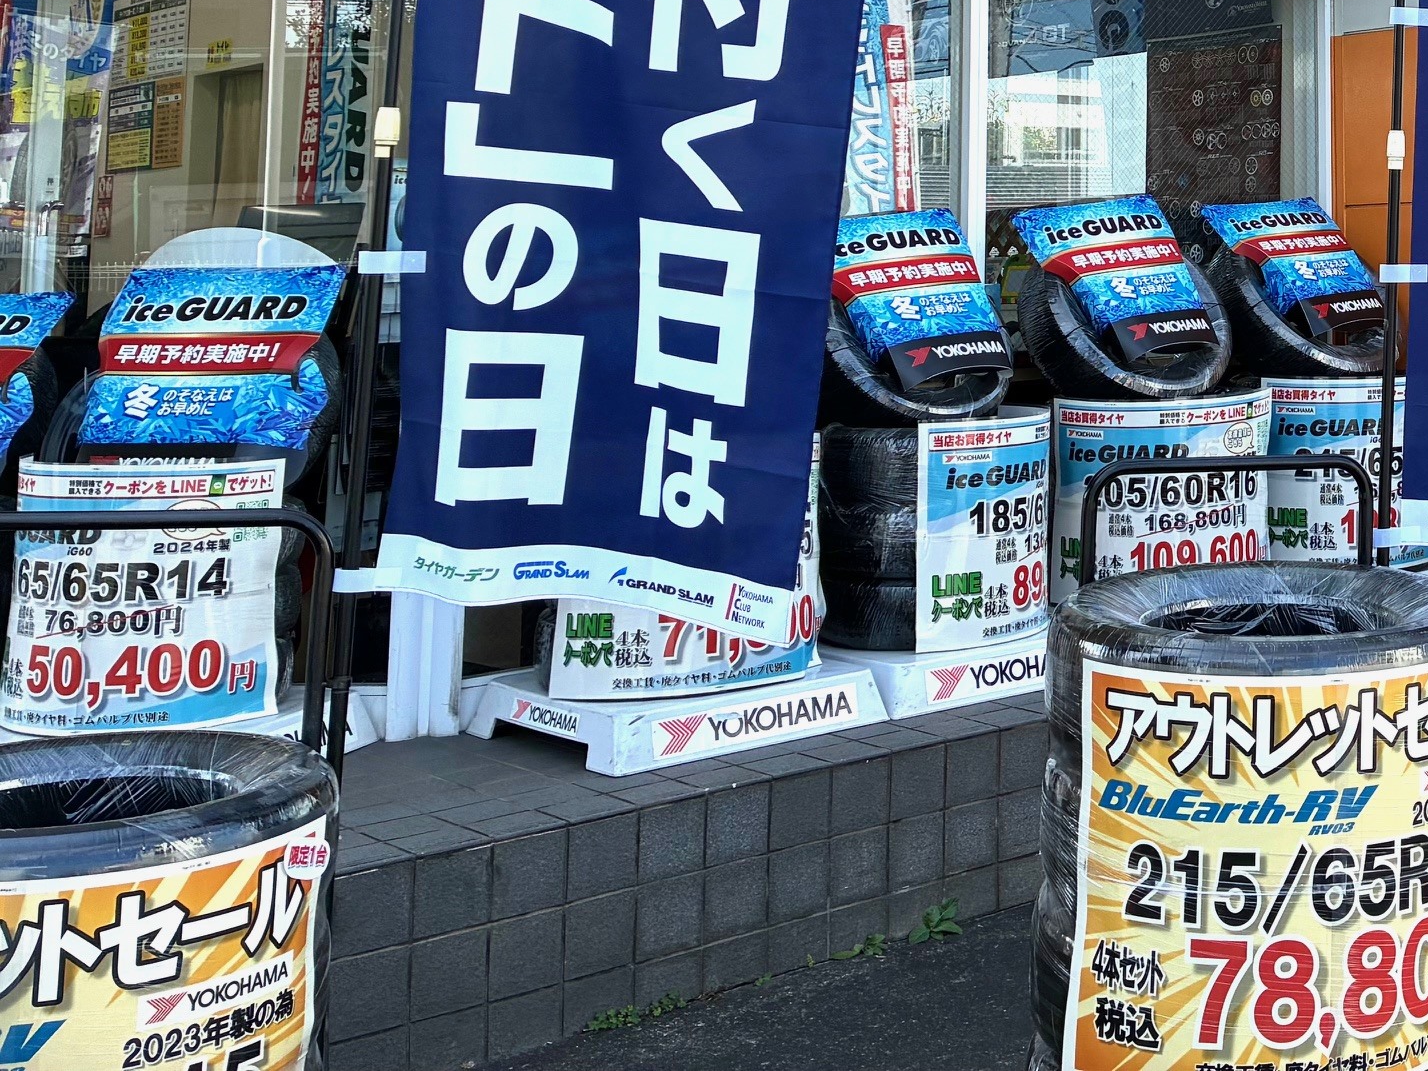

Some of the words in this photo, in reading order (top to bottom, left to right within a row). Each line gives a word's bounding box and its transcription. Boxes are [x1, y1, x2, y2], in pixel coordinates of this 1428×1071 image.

[1043, 213, 1163, 245] iceGUARD
[1229, 212, 1328, 233] iceGUARD
[1257, 234, 1347, 252] 早期予約実施中!
[1071, 243, 1179, 269] 早期予約実施中!
[848, 260, 976, 288] 早期予約実施中!
[121, 295, 308, 324] iceGUARD
[1330, 297, 1383, 315] YOKOHAMA
[1149, 317, 1210, 335] YOKOHAMA
[113, 342, 281, 365] 早期予約実施中!
[931, 340, 1006, 359] YOKOHAMA
[1061, 411, 1125, 425] 当店お買得タイヤ
[1228, 407, 1246, 419] LINE
[1278, 417, 1382, 437] iceGUAR
[933, 431, 1012, 448] 当店お買得タイヤ
[955, 454, 991, 462] YOKOHAMA
[103, 477, 167, 496] クーポンを
[170, 479, 207, 494] LINE
[1268, 507, 1307, 527] LINE
[1309, 522, 1335, 535] 4本
[67, 546, 93, 557] iG60
[153, 538, 232, 555] 2024年製
[1309, 535, 1337, 550] 税込
[413, 556, 500, 582] タイヤガーデン
[1098, 554, 1124, 570] 4本
[624, 576, 677, 597] GRAND
[677, 586, 716, 608] SLAM
[737, 584, 774, 606] YOKOHAMA
[931, 572, 983, 598] LINE
[984, 584, 1009, 600] 4本
[734, 597, 752, 613] CLUB
[931, 597, 984, 622] クーポンで
[984, 599, 1011, 619] 税込
[45, 605, 184, 640] 76,800円
[566, 613, 614, 639] LINE
[731, 610, 766, 630] NETWORK
[615, 629, 650, 648] 4本
[564, 640, 614, 667] クーポンで
[614, 647, 652, 667] 税込
[529, 703, 578, 734] YOKOHAMA
[707, 690, 854, 741] YOKOHAMA
[1098, 779, 1379, 826] BluEarth-RV
[1308, 821, 1355, 836] RV03
[287, 844, 327, 868] 限定1台
[1091, 939, 1165, 995] 4本セット
[187, 960, 289, 1012] YOKOHAMA
[123, 987, 295, 1069] 2023年製の為
[1094, 996, 1160, 1050] 税込
